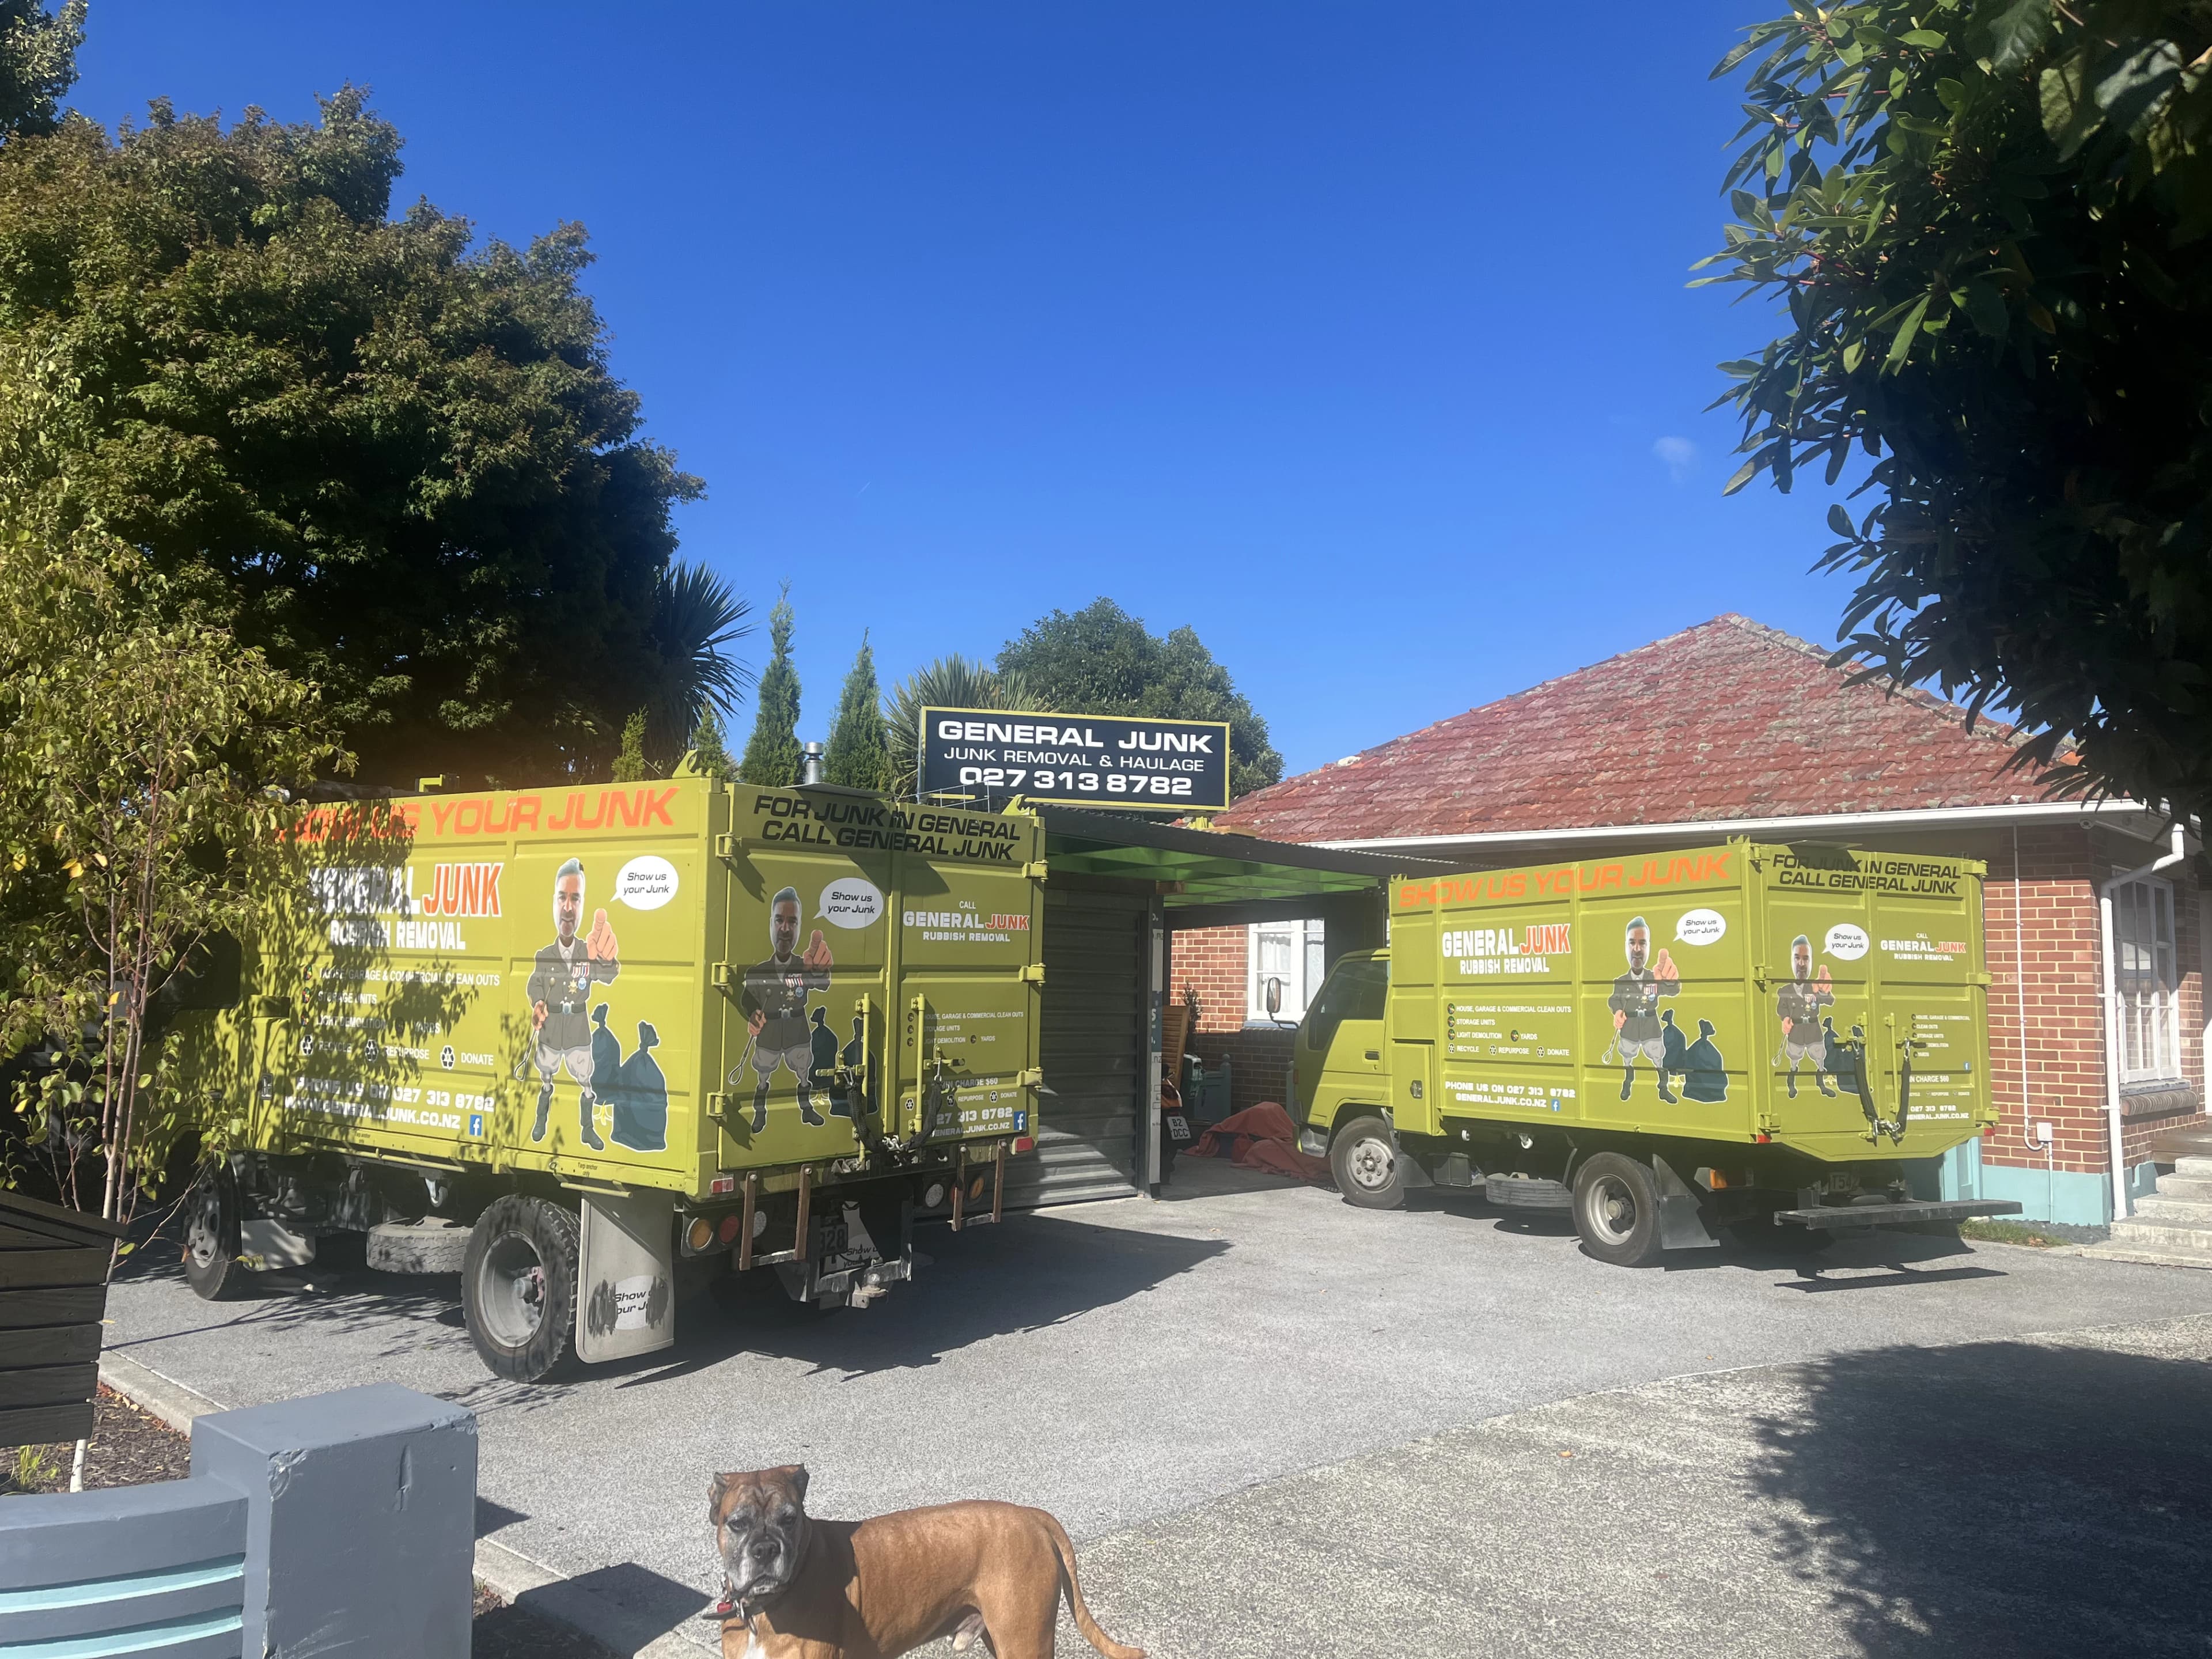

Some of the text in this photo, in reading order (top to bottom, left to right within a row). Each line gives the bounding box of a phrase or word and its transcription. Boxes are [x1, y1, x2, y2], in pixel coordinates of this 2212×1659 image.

[938, 720, 1213, 753] GENERAL JUNK
[944, 747, 1204, 771] JUNK REMOVAL & HAULAGE
[960, 767, 1192, 796] 027 313 8782
[430, 795, 541, 836] YOUR
[547, 787, 680, 830] JUNK
[753, 795, 1020, 840] FOR JUNK IN GENERAL
[762, 820, 1015, 861] CALL GENERAL JUNK
[1773, 854, 1808, 869] FOR
[1865, 859, 1882, 874] IN
[1885, 861, 1961, 879] GENERAL
[627, 872, 654, 881] Show
[1399, 852, 1733, 907] SHOW US YOUR JUNK
[1779, 871, 1957, 894] CALL GENERAL JUNK
[307, 862, 504, 917] GENERAL JUNK
[623, 885, 669, 896] your Junk
[831, 891, 859, 901] Show
[828, 905, 875, 914] your Junk
[959, 901, 976, 909] CALL
[903, 911, 1030, 930] GENERAL JUNK
[329, 920, 465, 950] RUBBISH REMOVAL
[923, 931, 1010, 942] RUBBISH REMOVAL
[1442, 923, 1571, 957] GENERAL JUNK
[1880, 940, 1966, 953] GENERAL JUNK
[1460, 957, 1550, 975] RUBBISH REMOVAL
[349, 969, 381, 980] GARAGE
[382, 970, 388, 981] &
[390, 970, 444, 983] COMMERCIAL
[445, 971, 474, 984] CLEAN
[476, 974, 500, 986] OUTS
[318, 991, 353, 1003] STORAGE
[340, 1016, 386, 1029] DEMOLITION
[414, 1021, 441, 1033] YARDS
[319, 1040, 494, 1066] RECYCLE REPURPOSE DONATE
[955, 1078, 984, 1088] CHARGE
[986, 1077, 998, 1085] $60
[1445, 1081, 1575, 1098] PHONE US ON 027 313 8782
[393, 1086, 421, 1103] 027
[426, 1090, 450, 1107] 313
[455, 1093, 495, 1112] 8782
[937, 1107, 1013, 1125] 27 313 8782
[615, 1291, 646, 1302] Show
[618, 1305, 636, 1315] our
